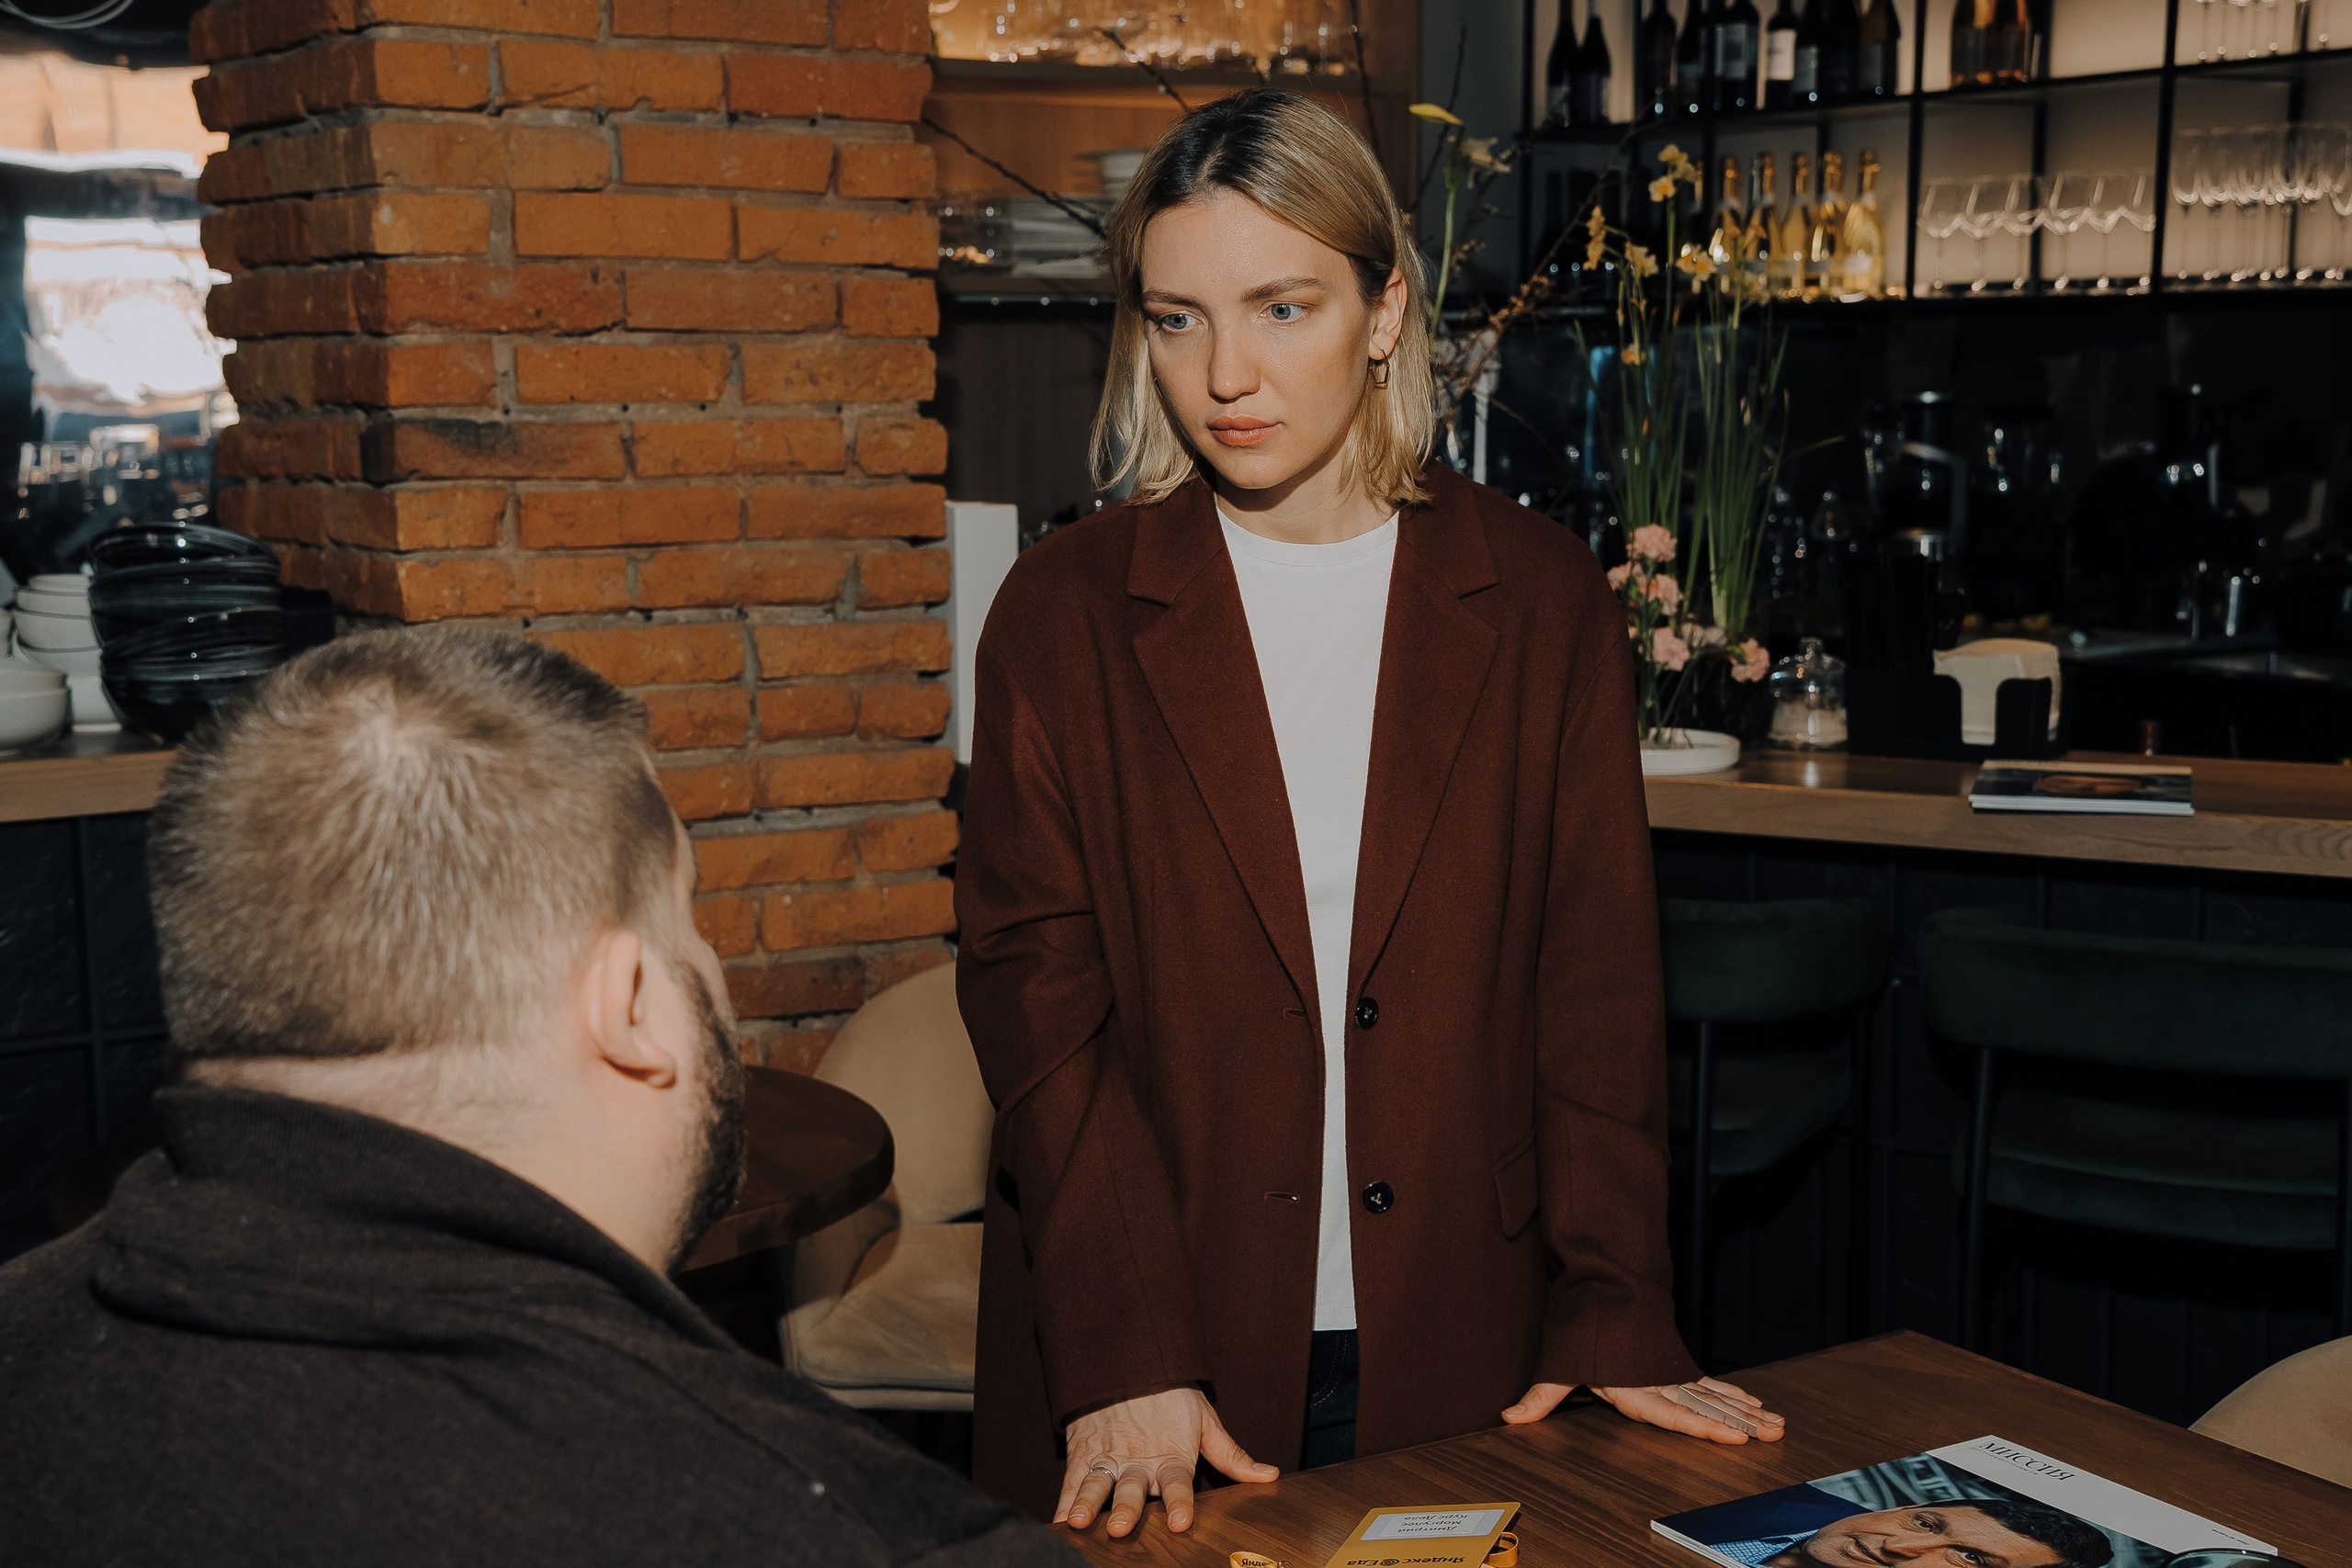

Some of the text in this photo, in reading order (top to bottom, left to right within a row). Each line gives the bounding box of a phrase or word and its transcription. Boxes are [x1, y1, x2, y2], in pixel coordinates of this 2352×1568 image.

[1978, 1442, 2076, 1481] МИССИЯ
[1241, 1558, 1270, 1567] Янде
[1401, 1556, 1466, 1564] Яндекс
